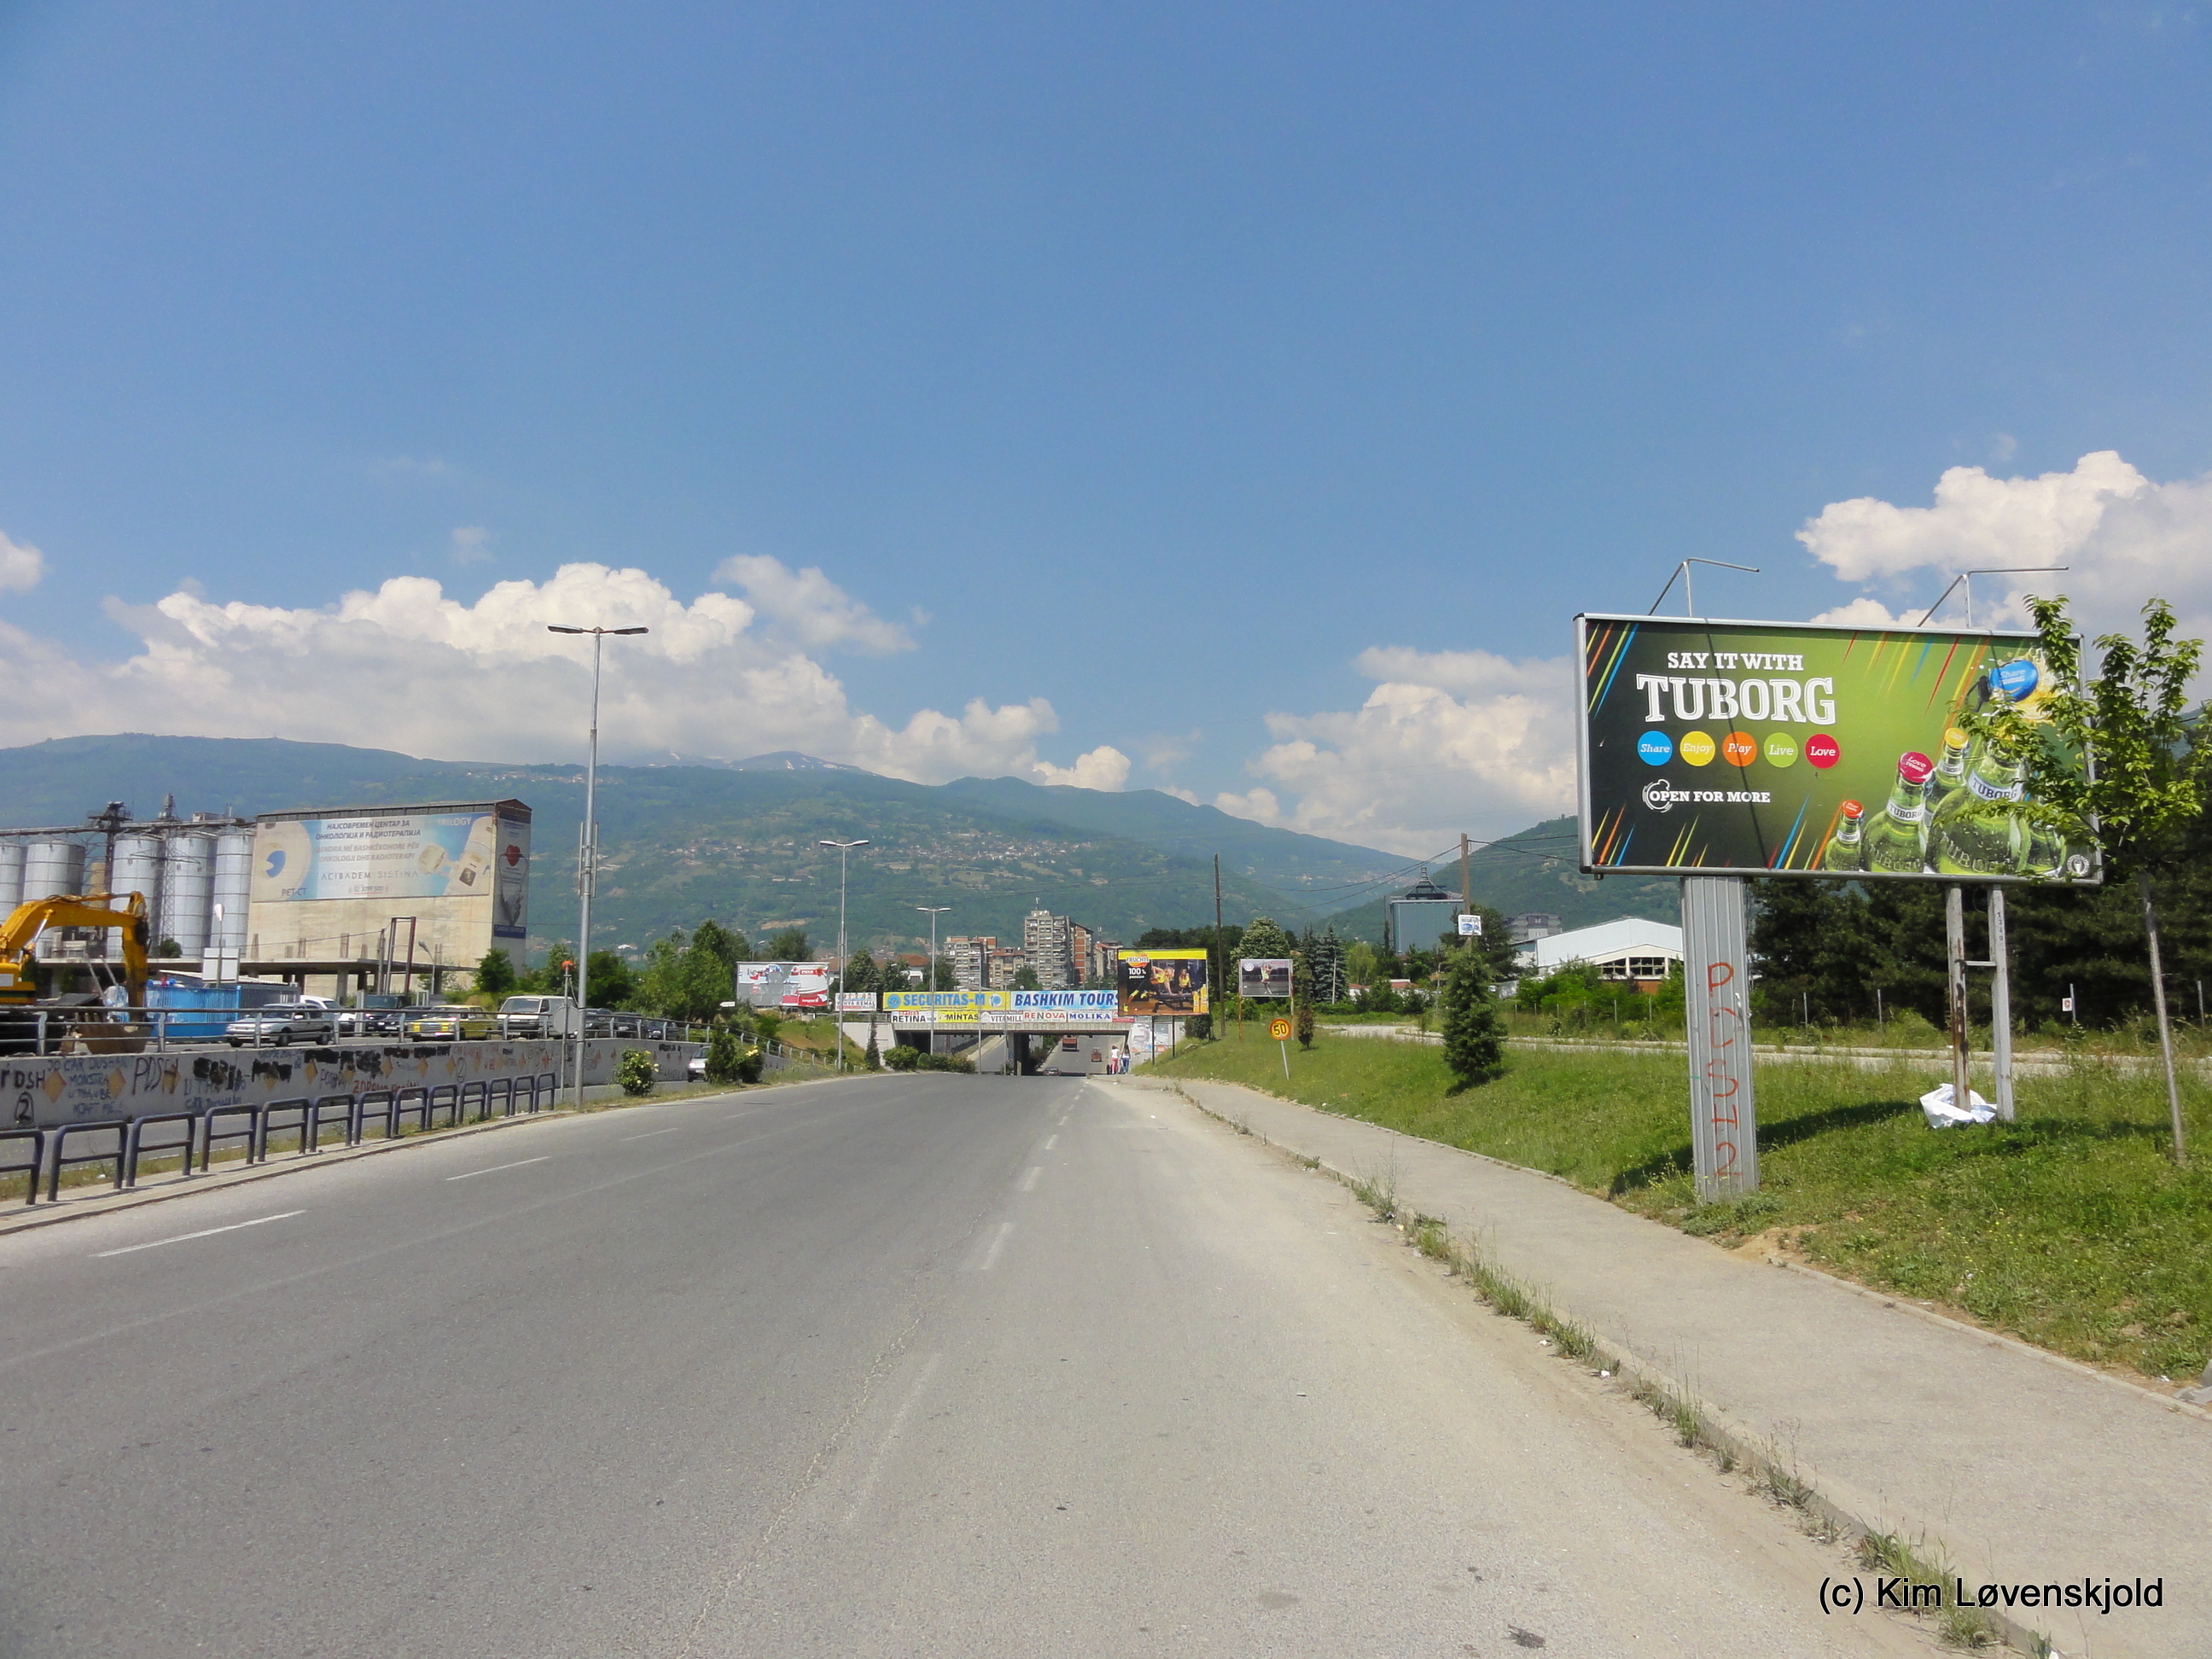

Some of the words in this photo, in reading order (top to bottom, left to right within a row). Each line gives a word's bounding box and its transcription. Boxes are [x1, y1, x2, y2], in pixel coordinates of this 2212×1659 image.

[1668, 652, 1709, 669] SAY
[1714, 653, 1738, 670] IT
[1740, 653, 1804, 671] WITH
[1636, 672, 1837, 725] TUBORG
[1640, 742, 1671, 754] Share
[1682, 742, 1713, 755] Enjoy
[1727, 742, 1752, 755] Play
[1769, 744, 1794, 756] Live
[1810, 746, 1837, 756] Love
[1649, 790, 1691, 802] OPEN
[1693, 791, 1724, 802] FOR
[1726, 791, 1771, 803] MORE
[321, 871, 371, 881] ACIBADEM
[377, 870, 418, 879] SISTINA
[903, 992, 985, 1007] SECURITAS-M
[1014, 992, 1078, 1007] BASHKIM
[1273, 1023, 1287, 1035] 50
